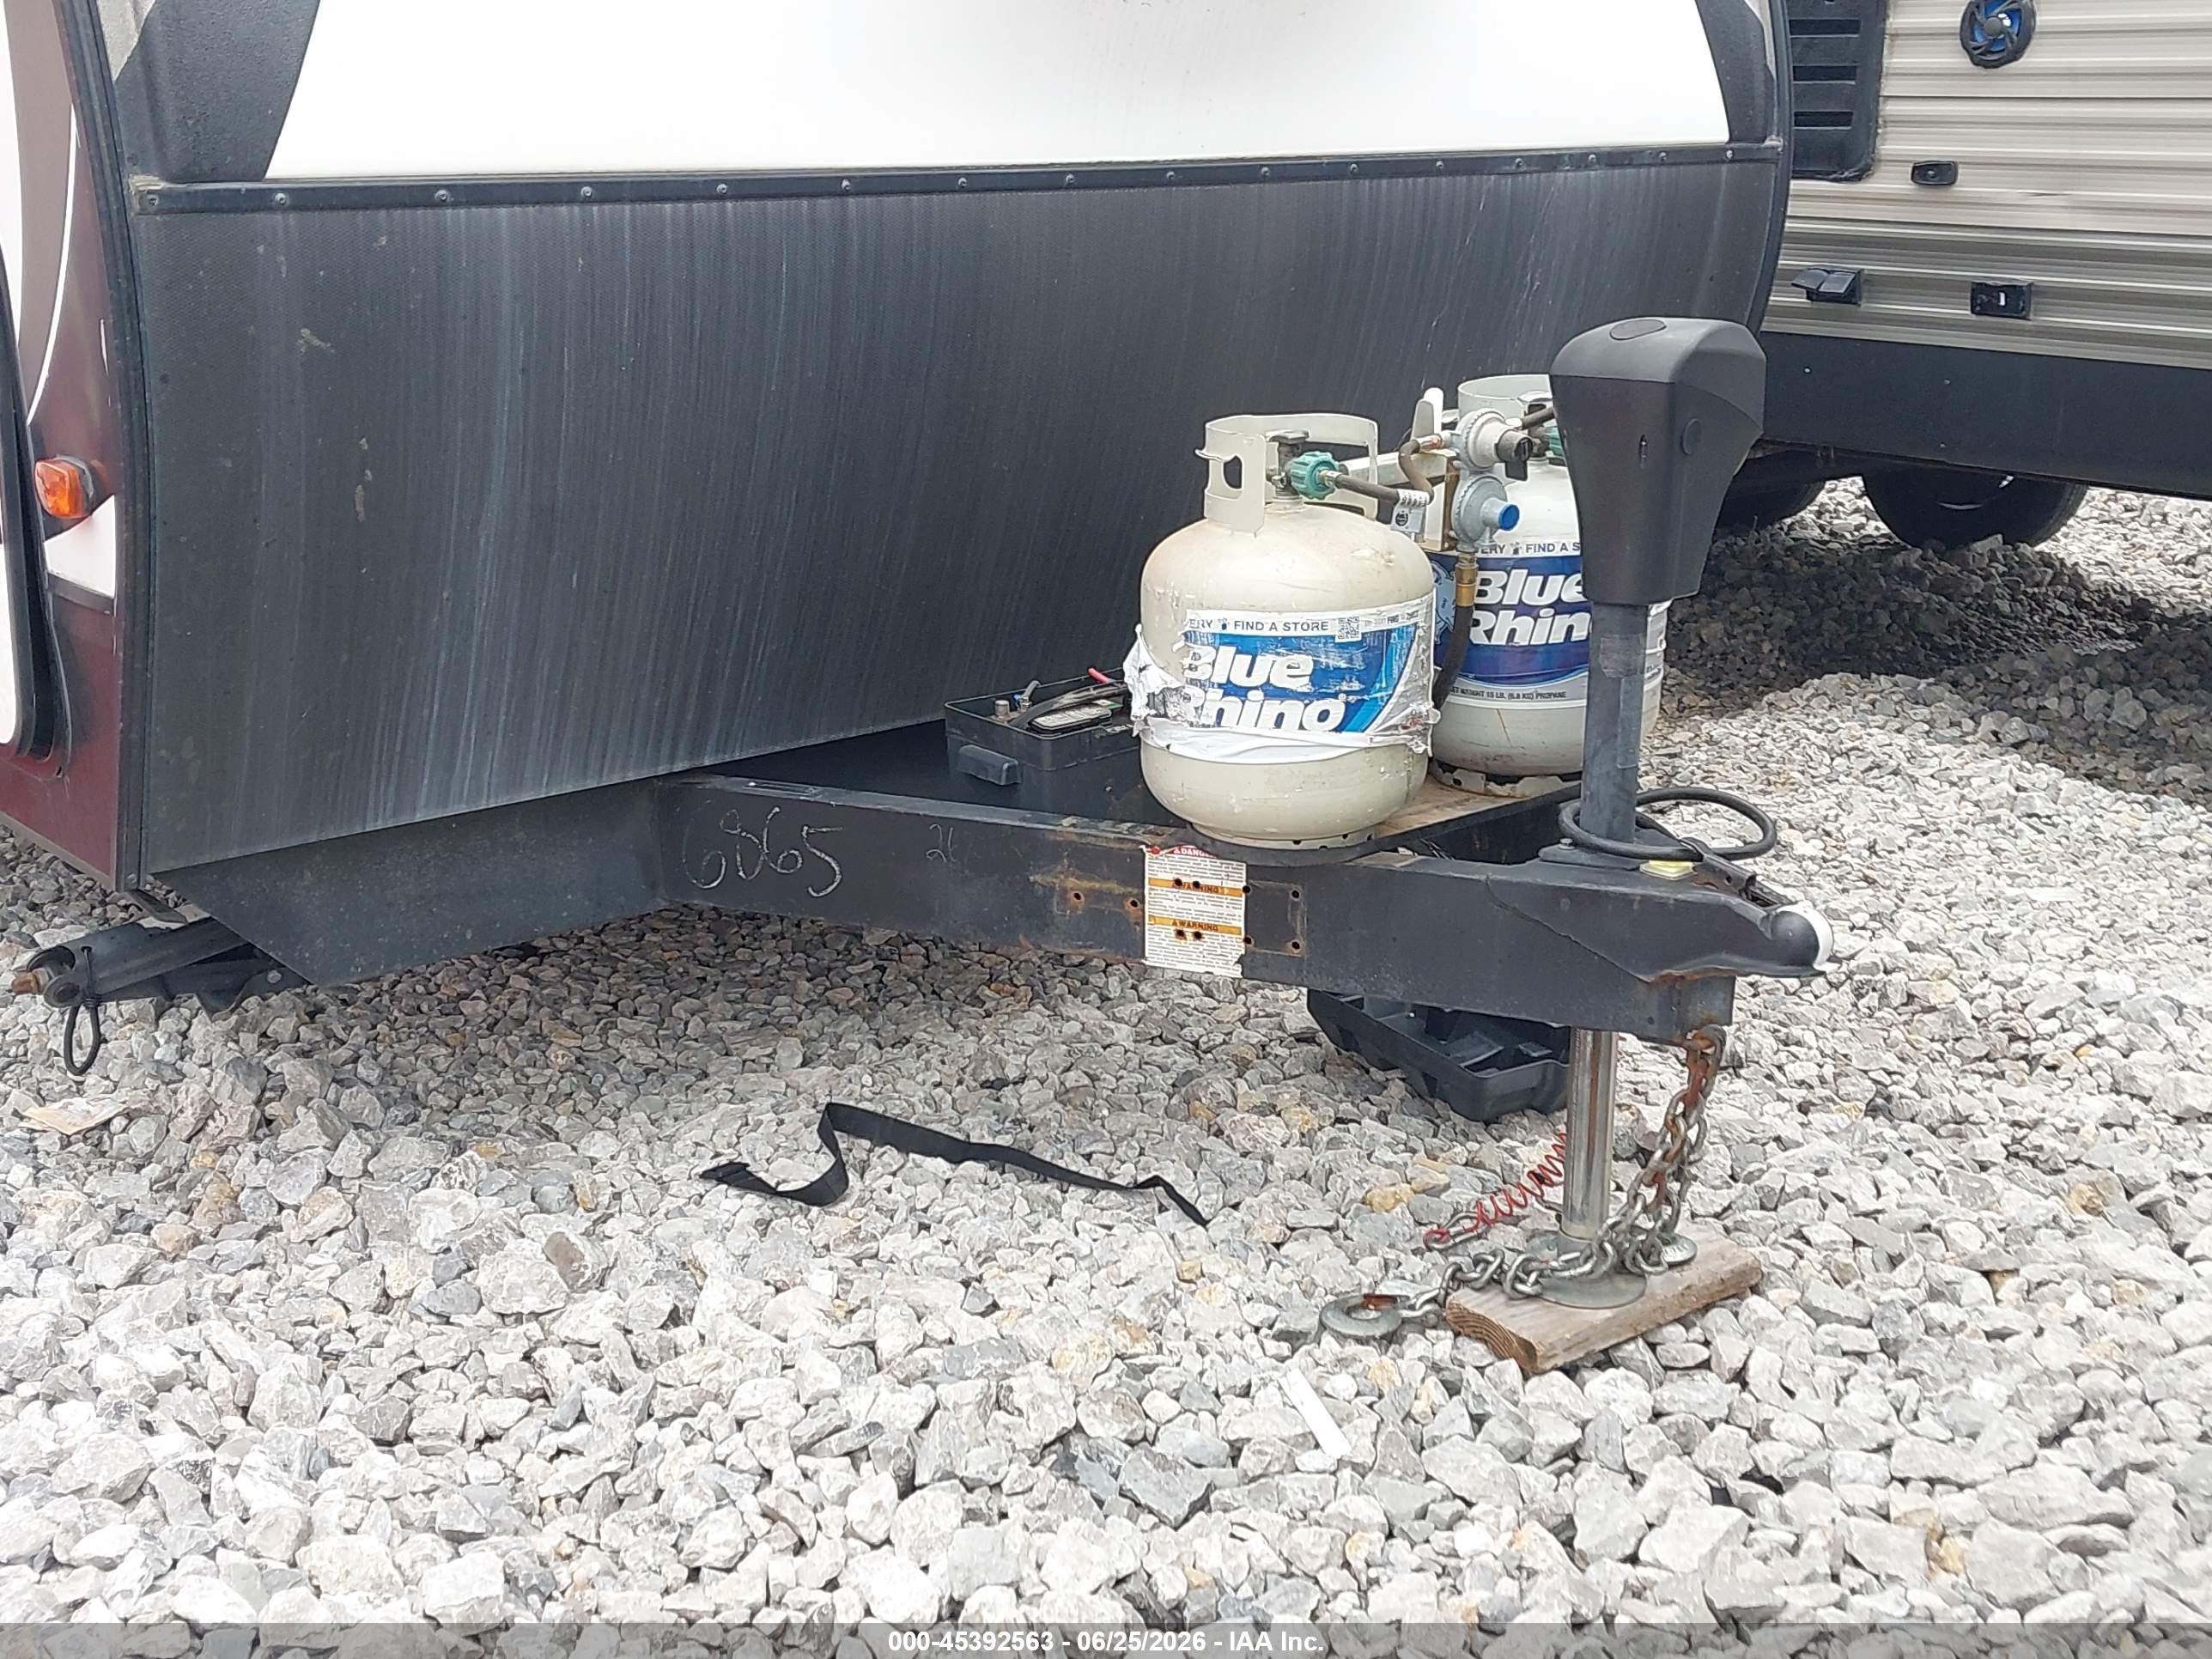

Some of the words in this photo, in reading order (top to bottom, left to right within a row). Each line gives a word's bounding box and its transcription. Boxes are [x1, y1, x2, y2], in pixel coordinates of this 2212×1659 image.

[1526, 543, 1555, 554] FIND
[1559, 542, 1569, 552] A
[1474, 568, 1588, 605] Blue
[1234, 620, 1265, 631] FIND
[1269, 621, 1279, 632] A
[1282, 620, 1329, 632] STORE
[1469, 607, 1591, 646] Rhin
[1182, 644, 1314, 690] Blue
[1534, 690, 1567, 700] PROPANE
[1179, 920, 1219, 933] WARNING
